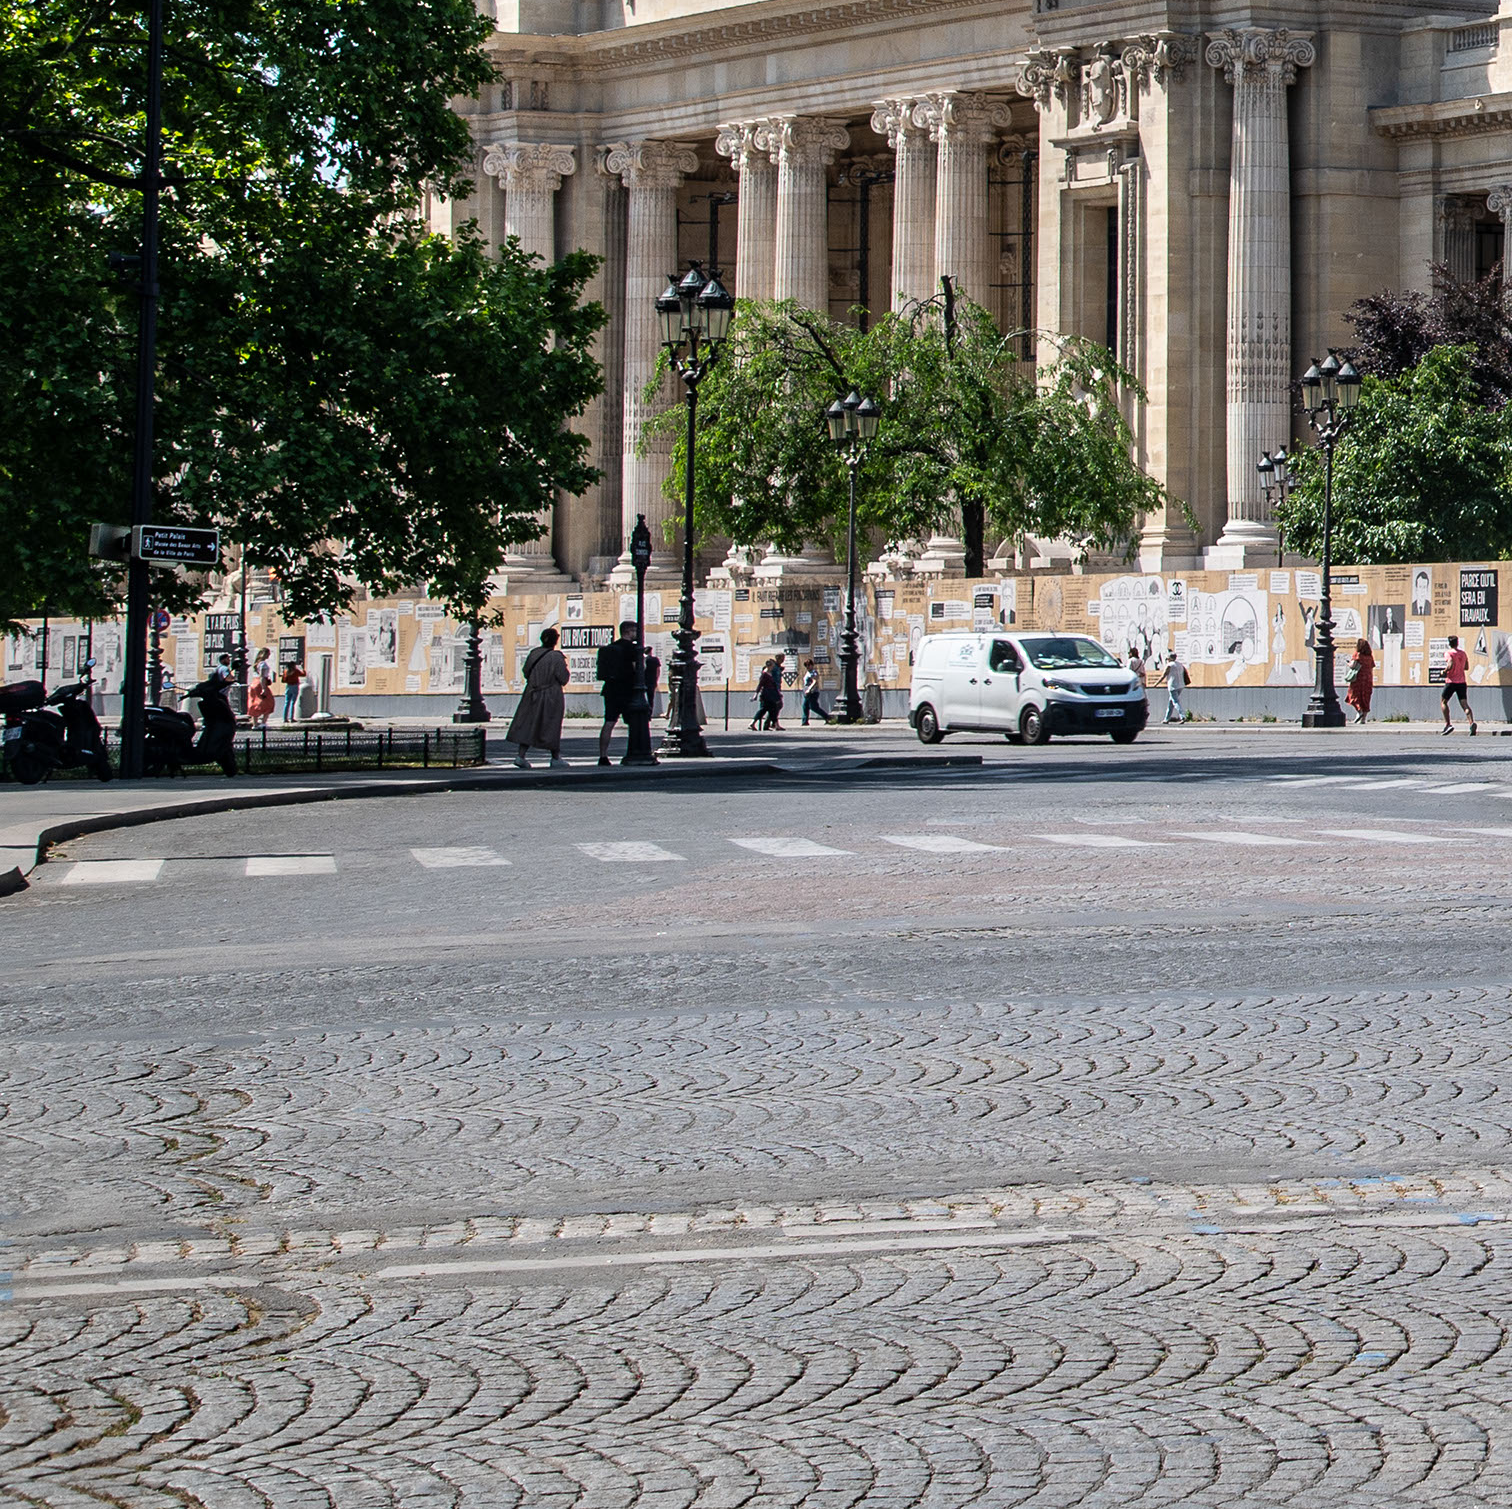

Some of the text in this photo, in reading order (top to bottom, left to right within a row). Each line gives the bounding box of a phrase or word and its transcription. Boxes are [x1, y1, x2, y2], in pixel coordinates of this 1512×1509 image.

[154, 531, 168, 539] Petit
[1462, 573, 1496, 588] PARCE QU'IL
[1461, 591, 1485, 606] SERA EN
[1461, 608, 1490, 622] TRAVAUX.
[226, 616, 239, 629] PLUS
[212, 634, 224, 648] PLUS
[562, 629, 571, 646] UN
[572, 629, 590, 646] RIVET
